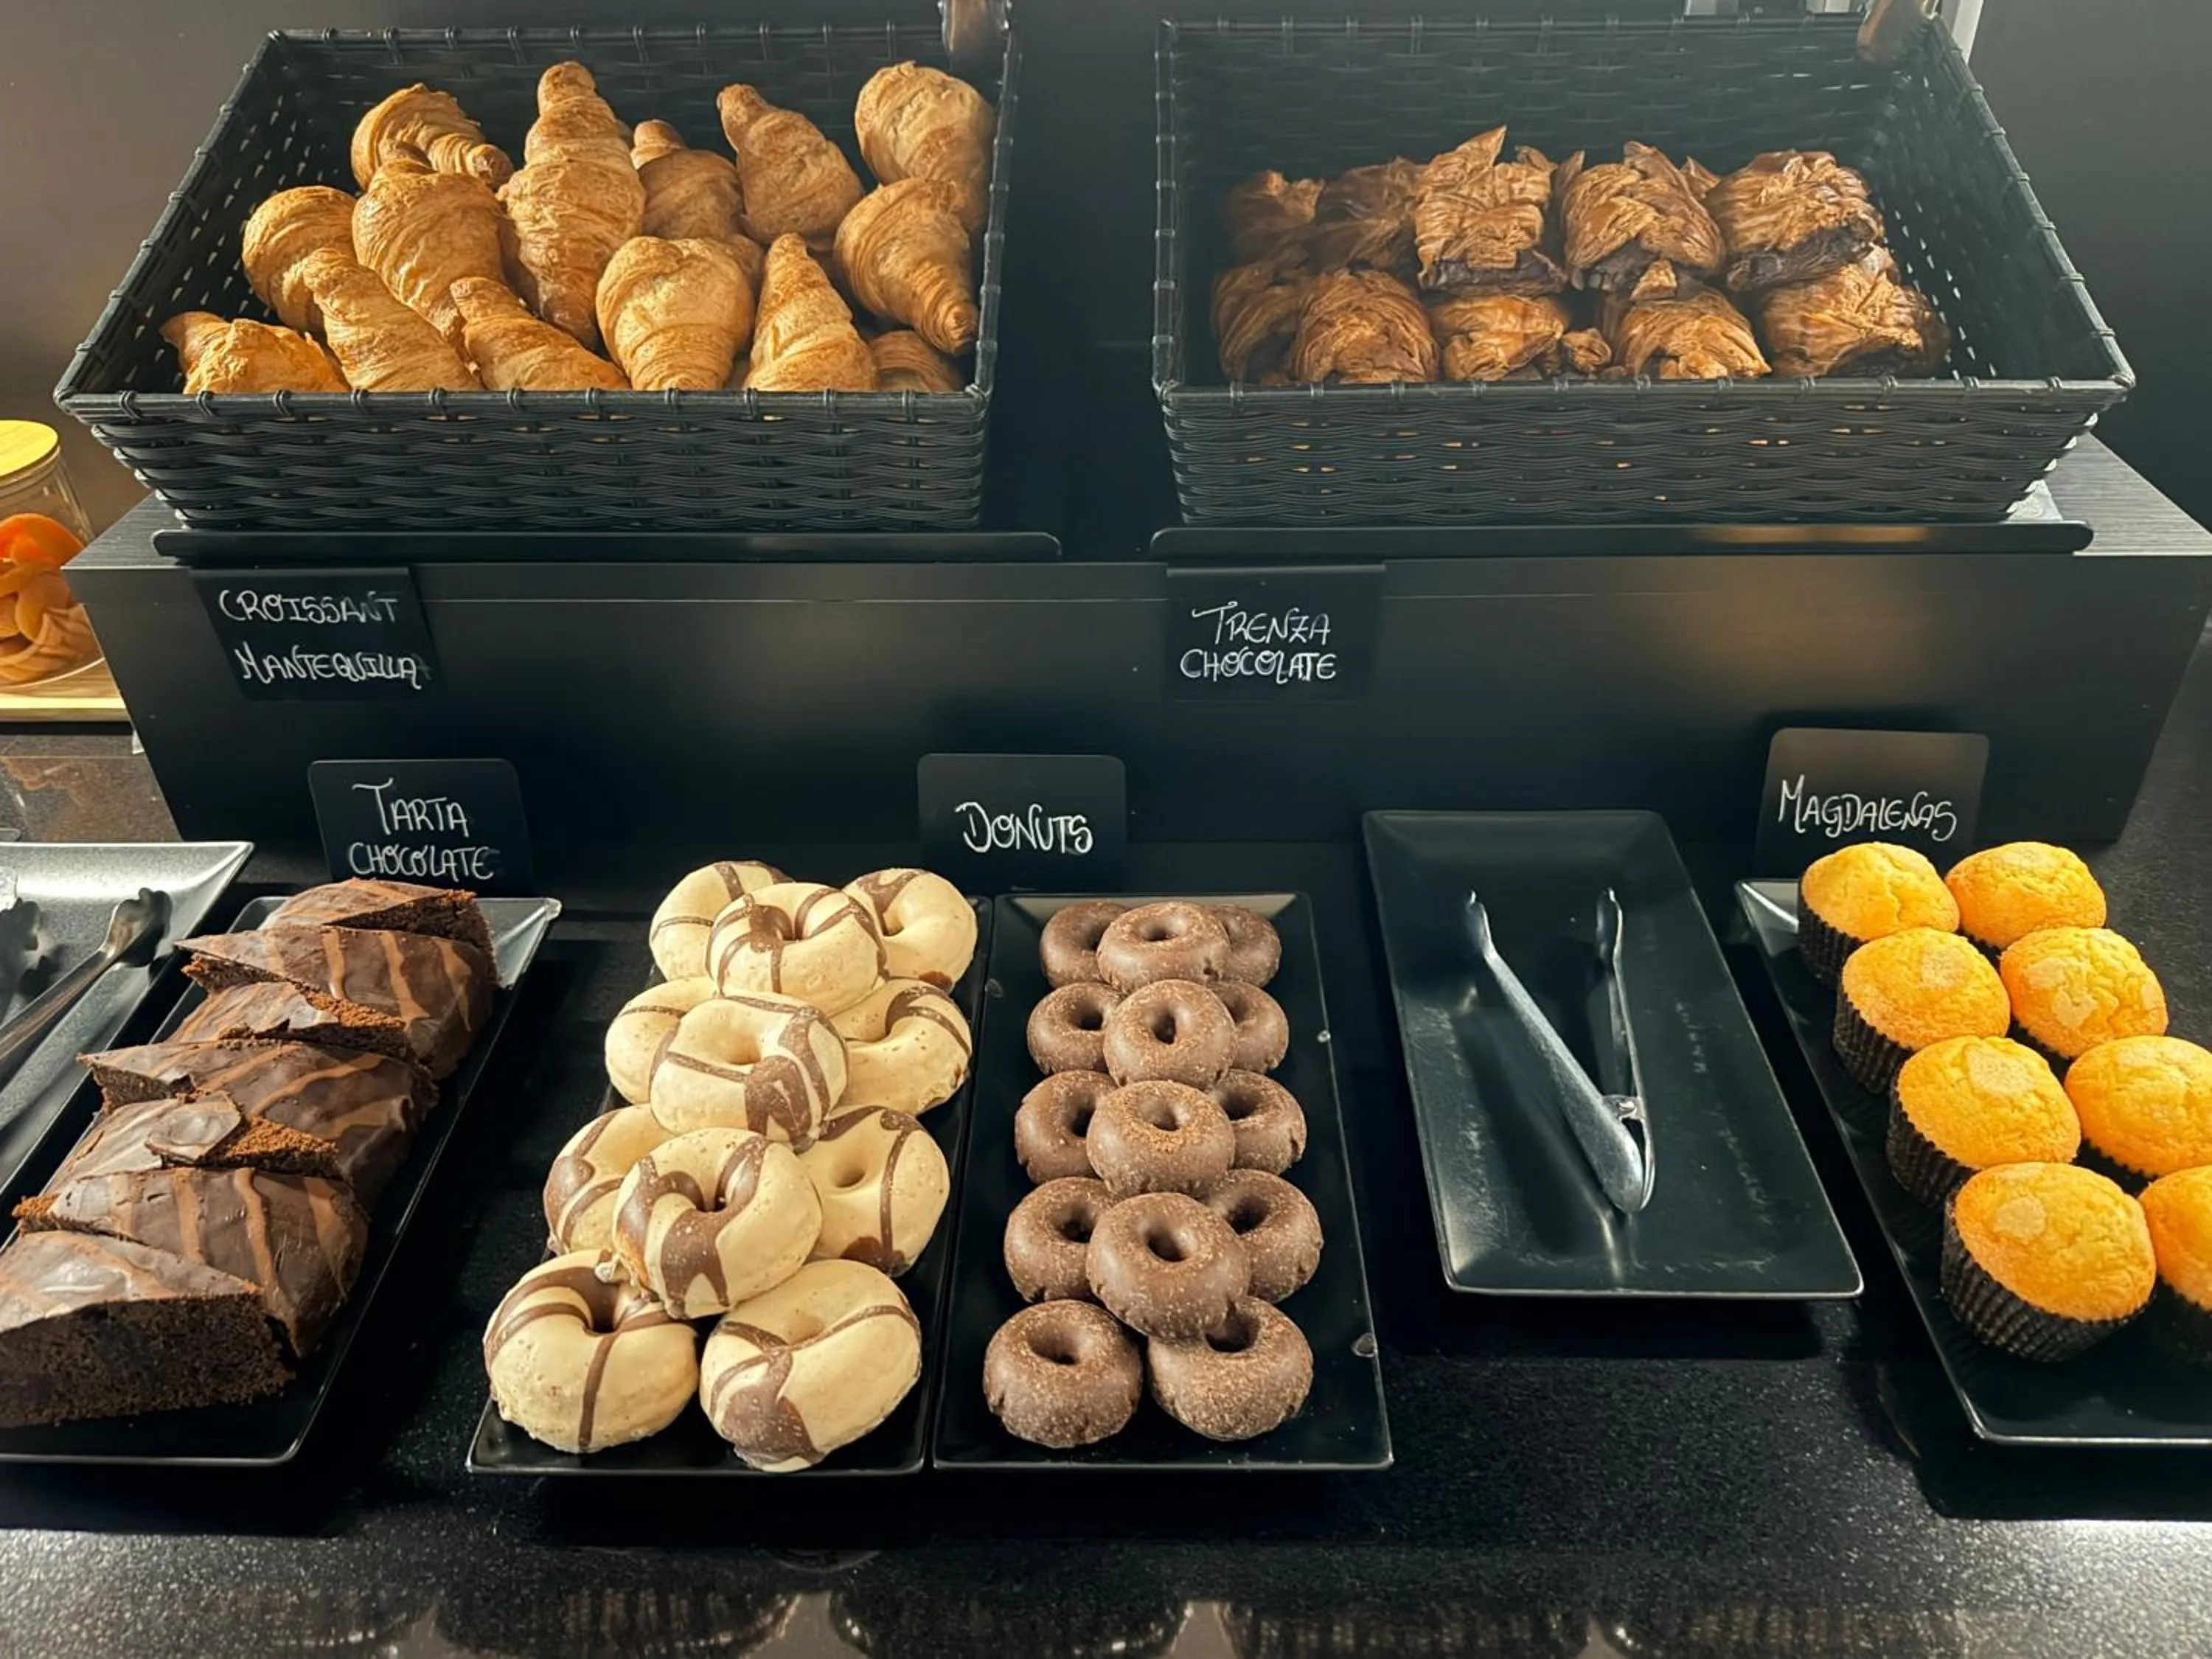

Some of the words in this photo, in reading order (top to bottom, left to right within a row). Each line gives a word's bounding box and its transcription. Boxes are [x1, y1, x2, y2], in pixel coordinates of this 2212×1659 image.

[219, 589, 399, 623] CROISSANT
[1192, 601, 1331, 645] TRENZA
[234, 641, 422, 689] MANTEQUILLA
[1180, 646, 1337, 684] CHOCOLATE
[352, 778, 469, 837] TARTA
[955, 801, 1094, 854] DONUTS
[1778, 774, 1958, 841] MAGDALENAS
[349, 841, 495, 883] CHOCOLATE
